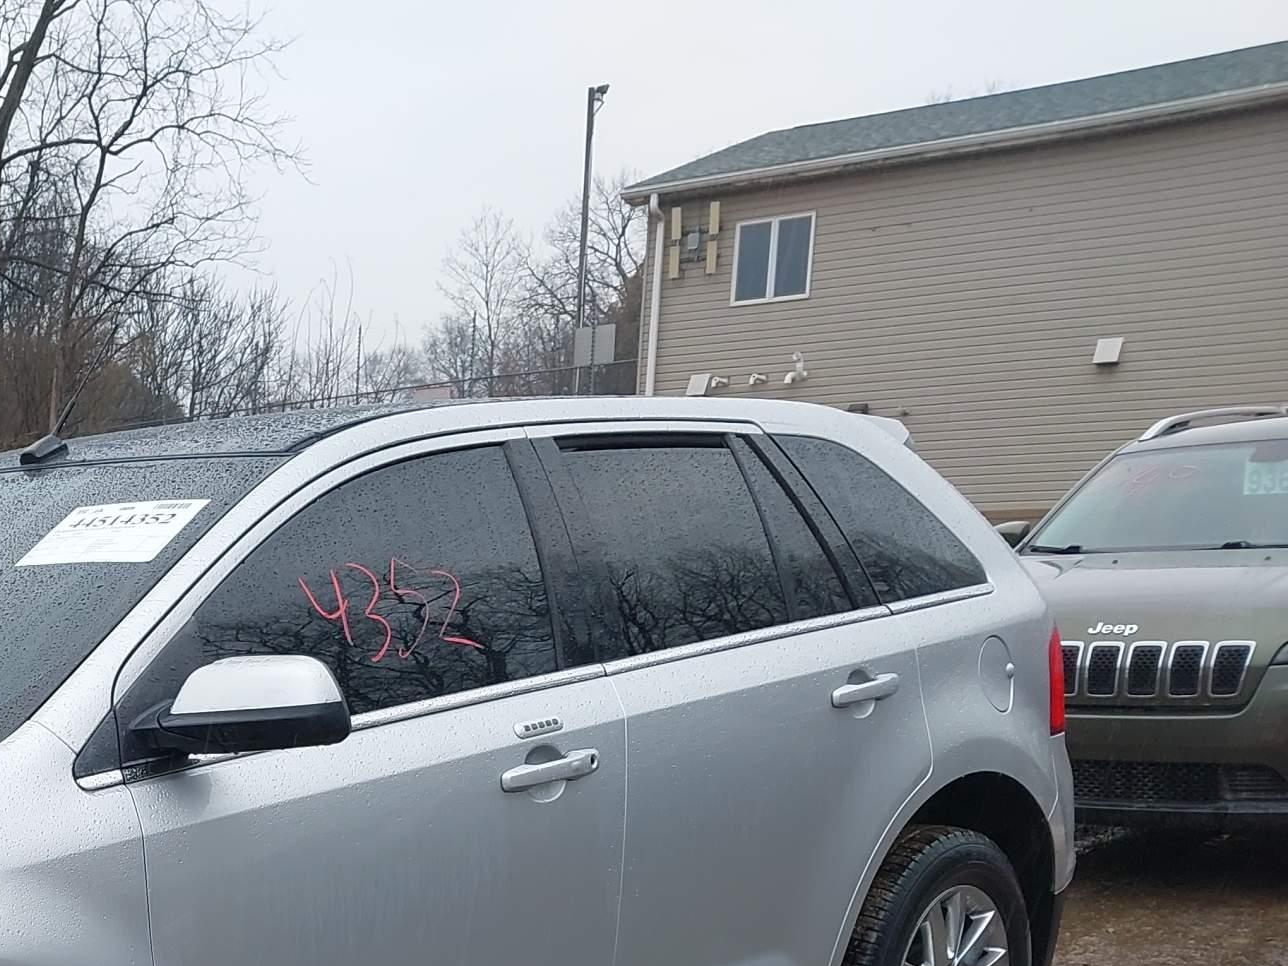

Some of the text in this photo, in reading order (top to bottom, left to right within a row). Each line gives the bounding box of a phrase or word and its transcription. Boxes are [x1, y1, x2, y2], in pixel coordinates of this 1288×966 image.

[68, 513, 177, 529] 44514352
[297, 556, 486, 663] 4352
[1087, 622, 1138, 636] Jeep
